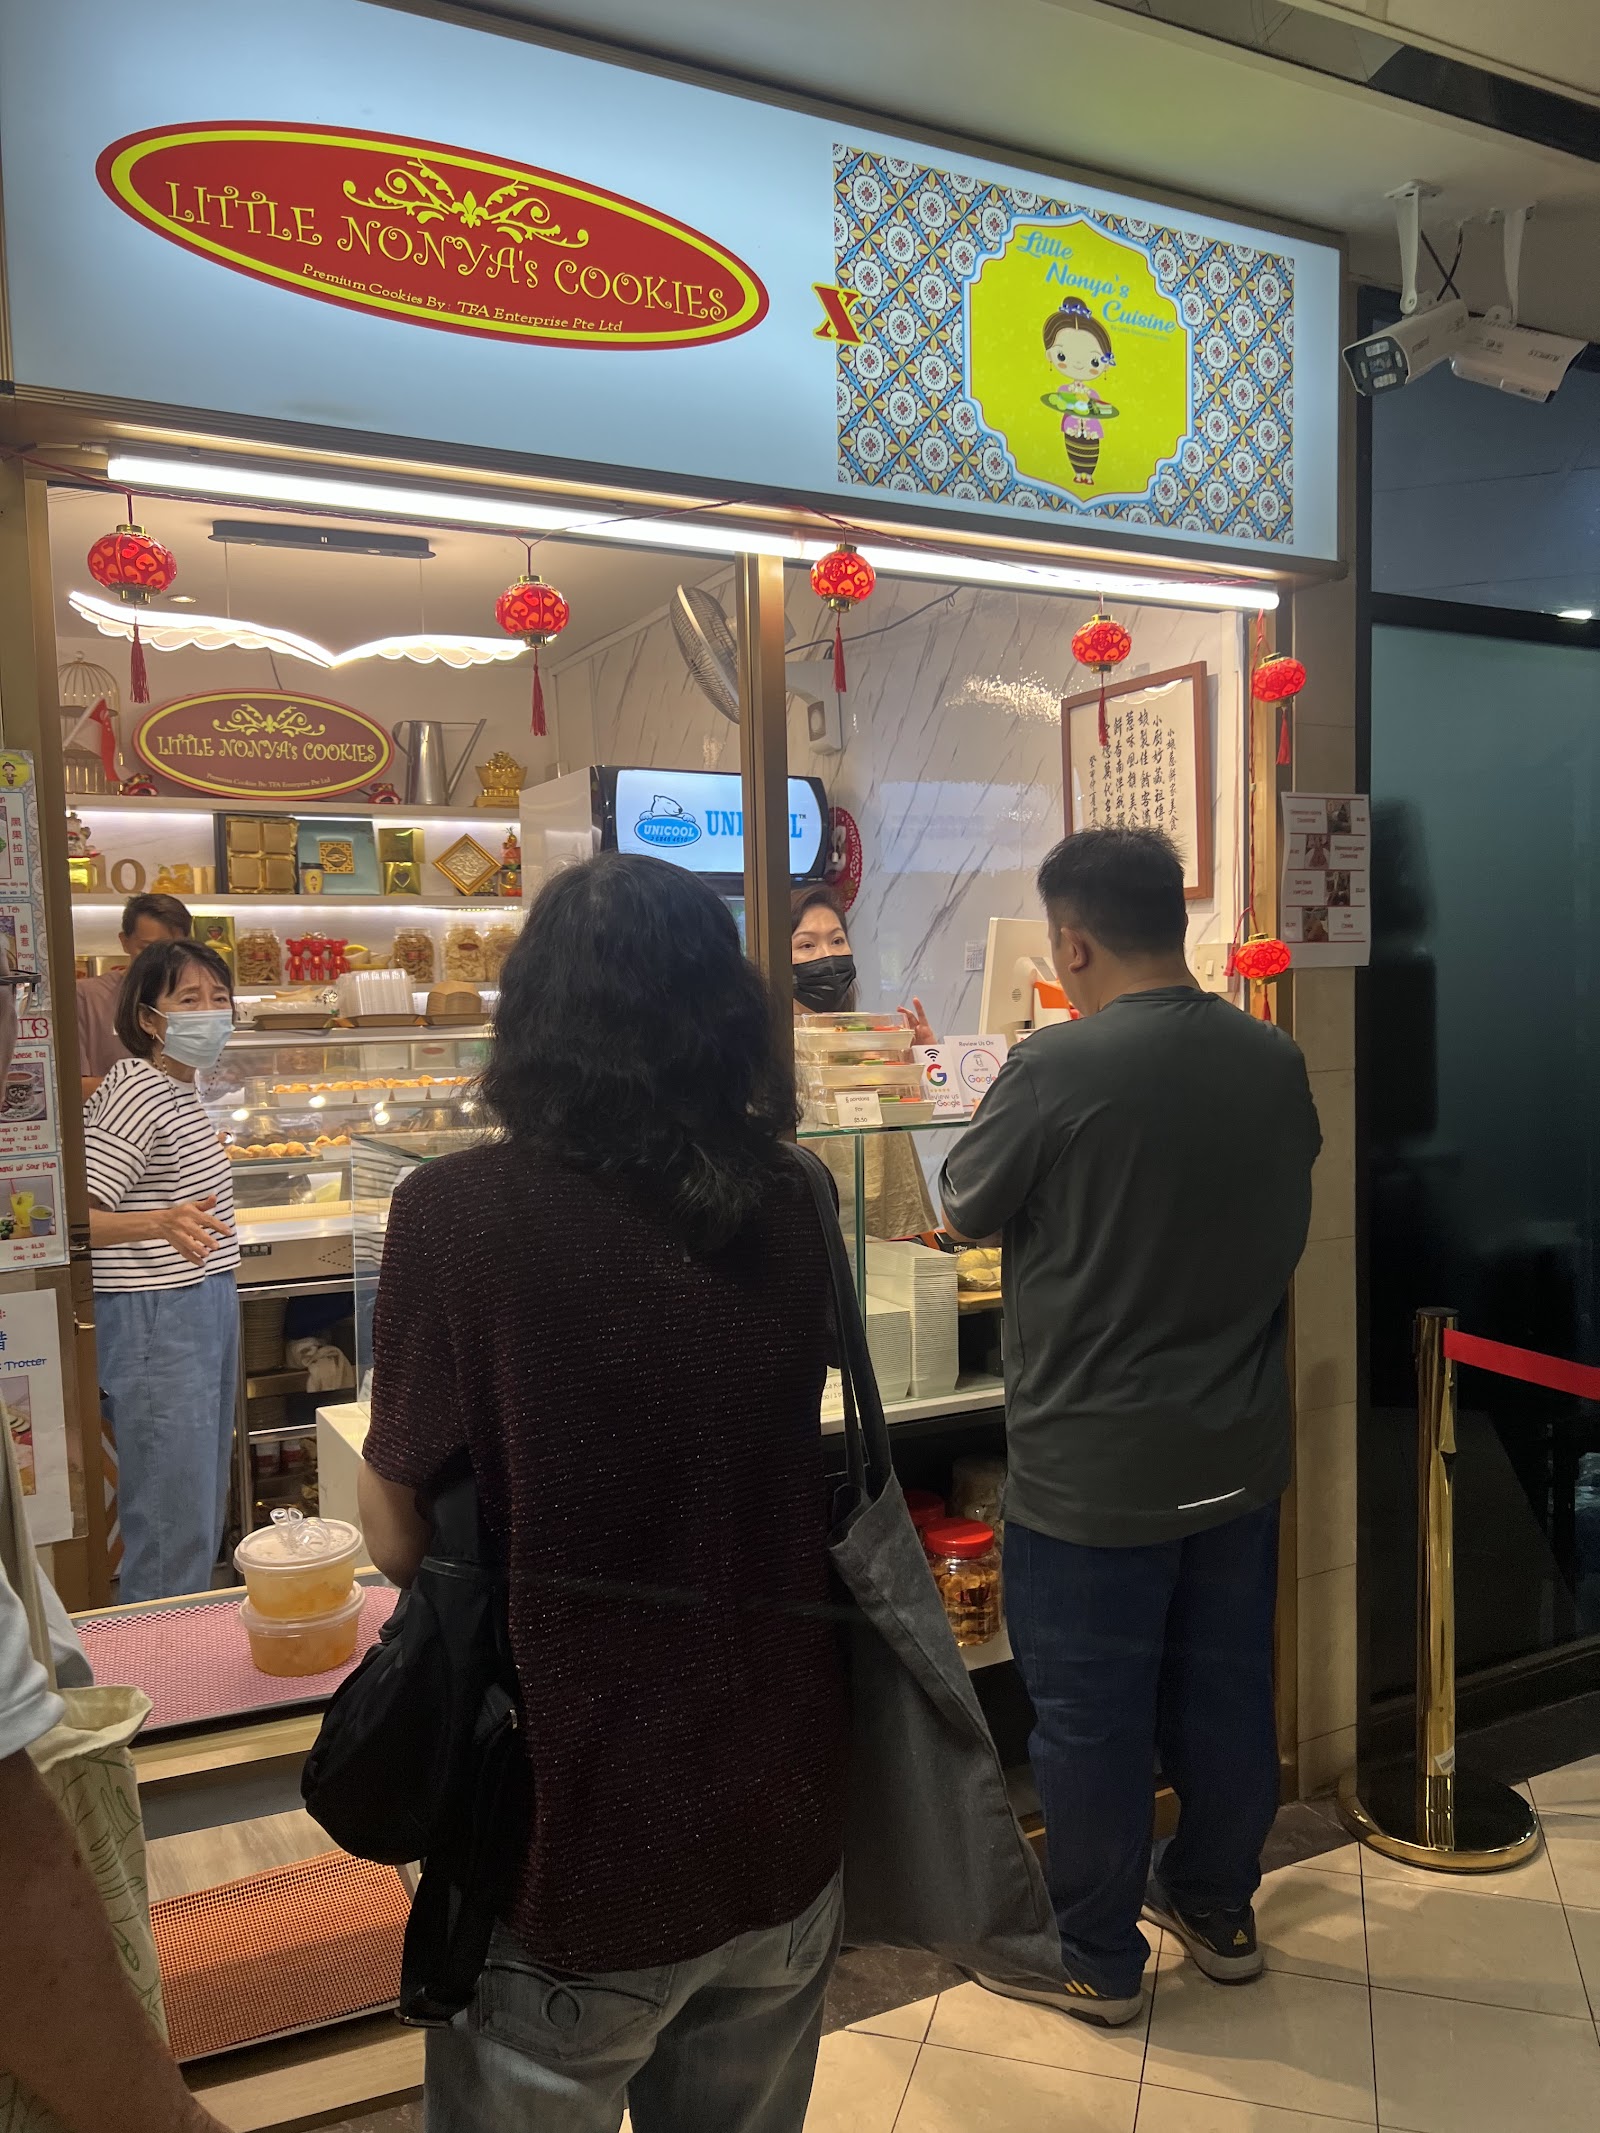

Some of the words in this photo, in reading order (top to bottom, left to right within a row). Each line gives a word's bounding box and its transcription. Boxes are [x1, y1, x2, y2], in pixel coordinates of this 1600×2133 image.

[165, 182, 322, 245] LITTLE
[337, 216, 538, 288] NONYA's
[554, 260, 728, 321] COOKIES
[1016, 231, 1073, 260] Little
[1045, 261, 1130, 298] Nonya's
[302, 263, 366, 291] Premium
[369, 283, 423, 305] Cookies
[457, 301, 490, 318] TFA
[493, 308, 569, 328] Enterprise
[572, 318, 595, 331] Pte
[599, 320, 623, 332] Ltd
[812, 284, 863, 345] X
[1102, 300, 1176, 334] Cuisine
[157, 733, 214, 757] LITTLE
[219, 738, 298, 760] NONYA's
[302, 742, 377, 763] COOKIES
[643, 824, 695, 838] UNICOOL
[936, 1099, 961, 1108] Google
[4, 1358, 48, 1371] Trotter
